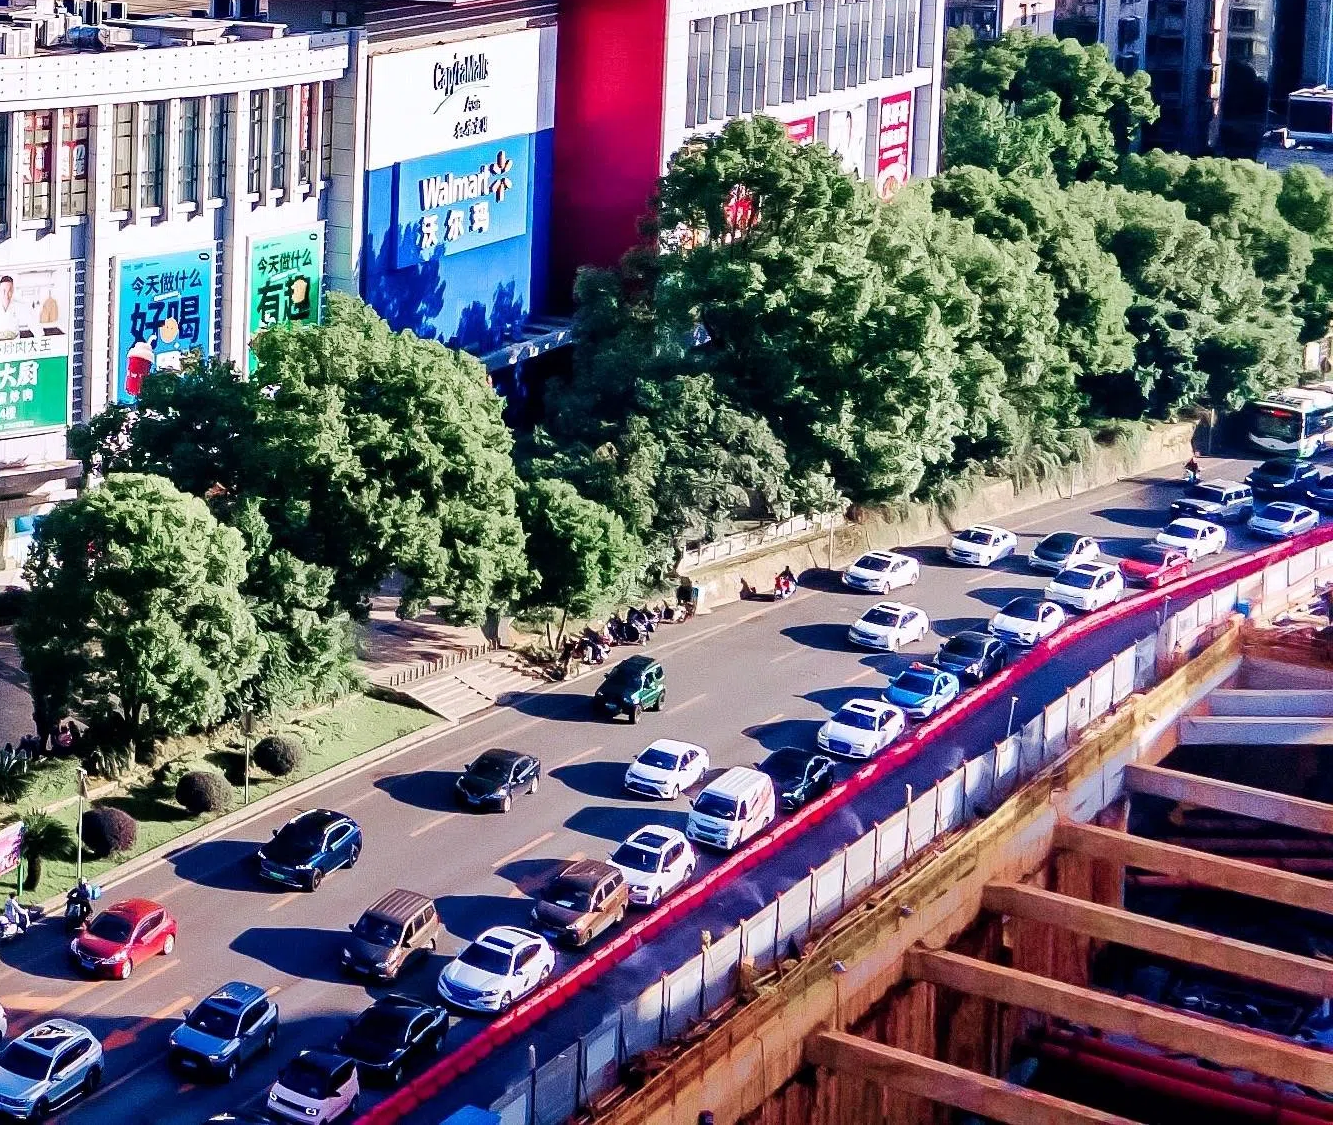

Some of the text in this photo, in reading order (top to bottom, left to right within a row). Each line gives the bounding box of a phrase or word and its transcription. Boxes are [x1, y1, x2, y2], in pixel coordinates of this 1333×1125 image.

[420, 165, 493, 211] Walmart
[419, 201, 490, 249] 沃尔玛
[131, 268, 202, 296] 今天做什么
[257, 248, 312, 276] 今天做什么
[129, 295, 200, 350] 好喝
